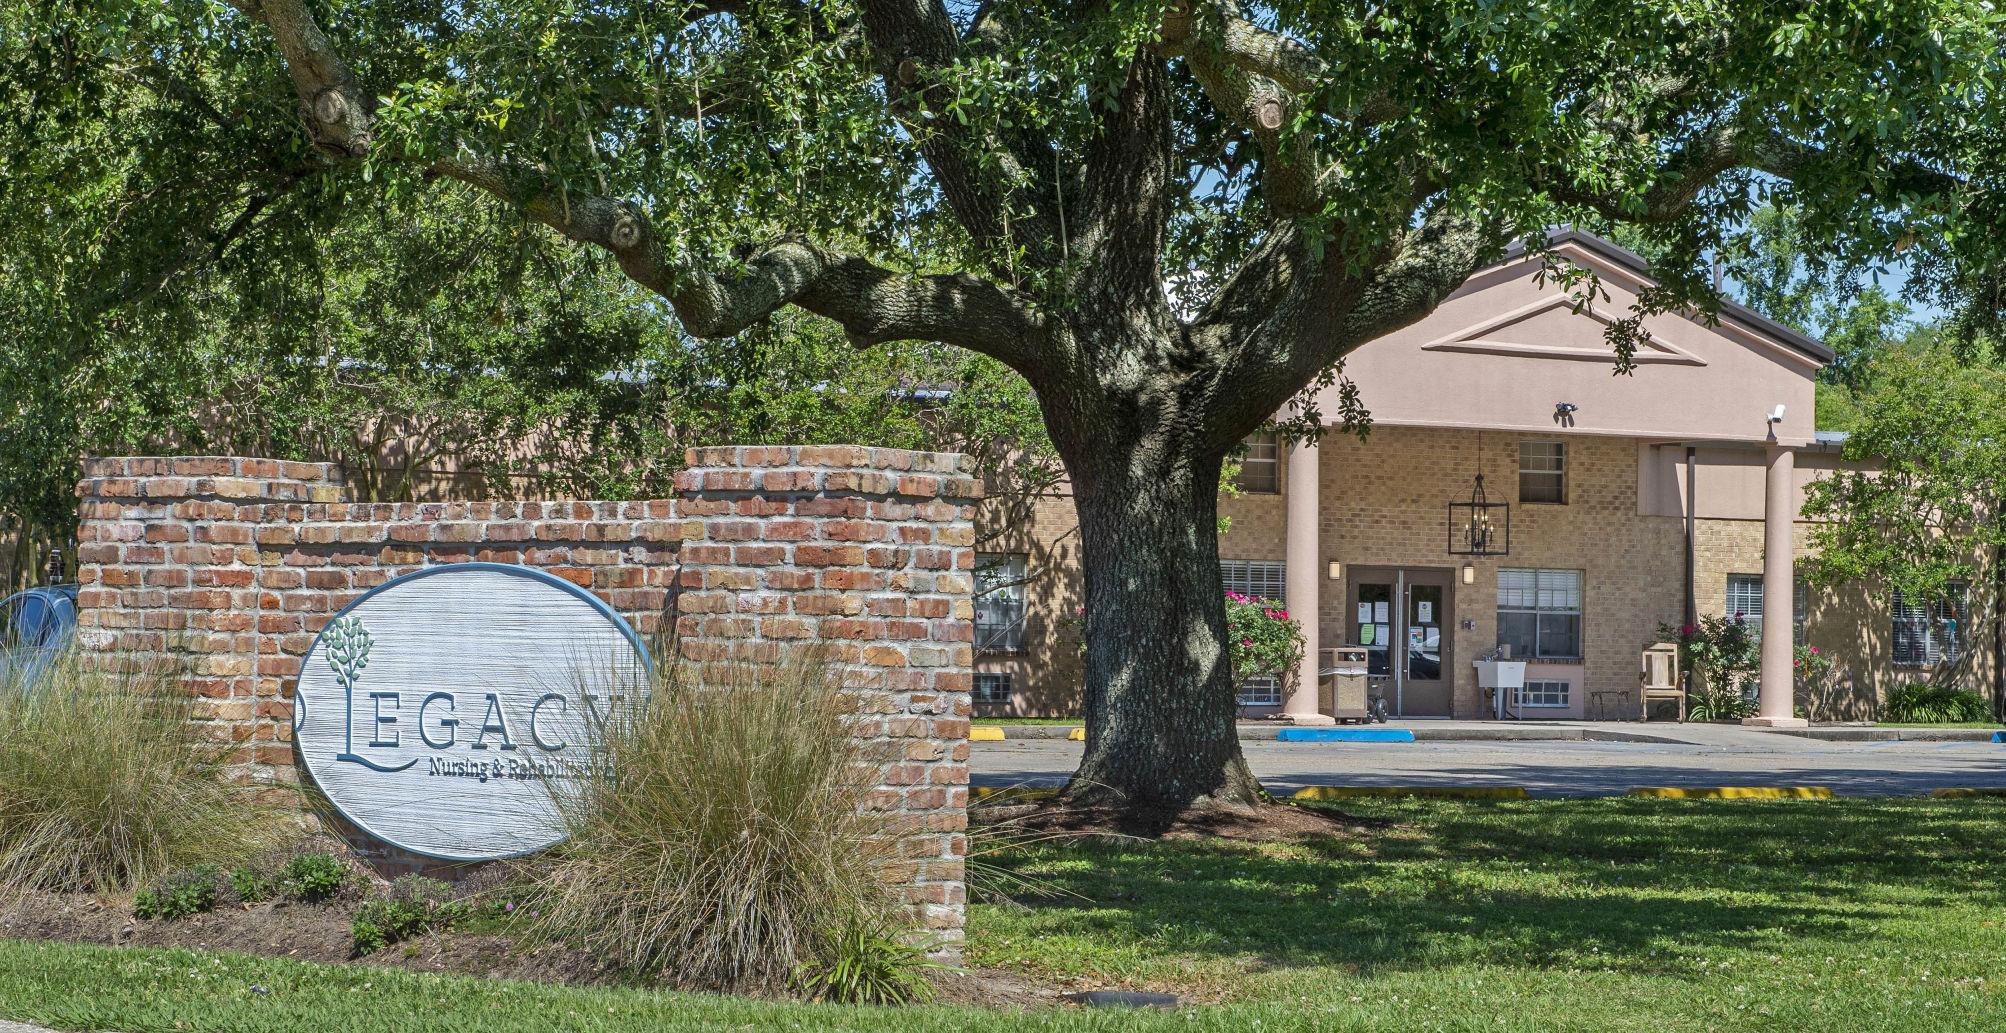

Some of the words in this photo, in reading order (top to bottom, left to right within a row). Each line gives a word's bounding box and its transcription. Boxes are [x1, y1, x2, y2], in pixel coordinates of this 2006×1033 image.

[336, 679, 625, 773] LEGACY
[428, 756, 488, 783] Nursing
[492, 757, 505, 778] &
